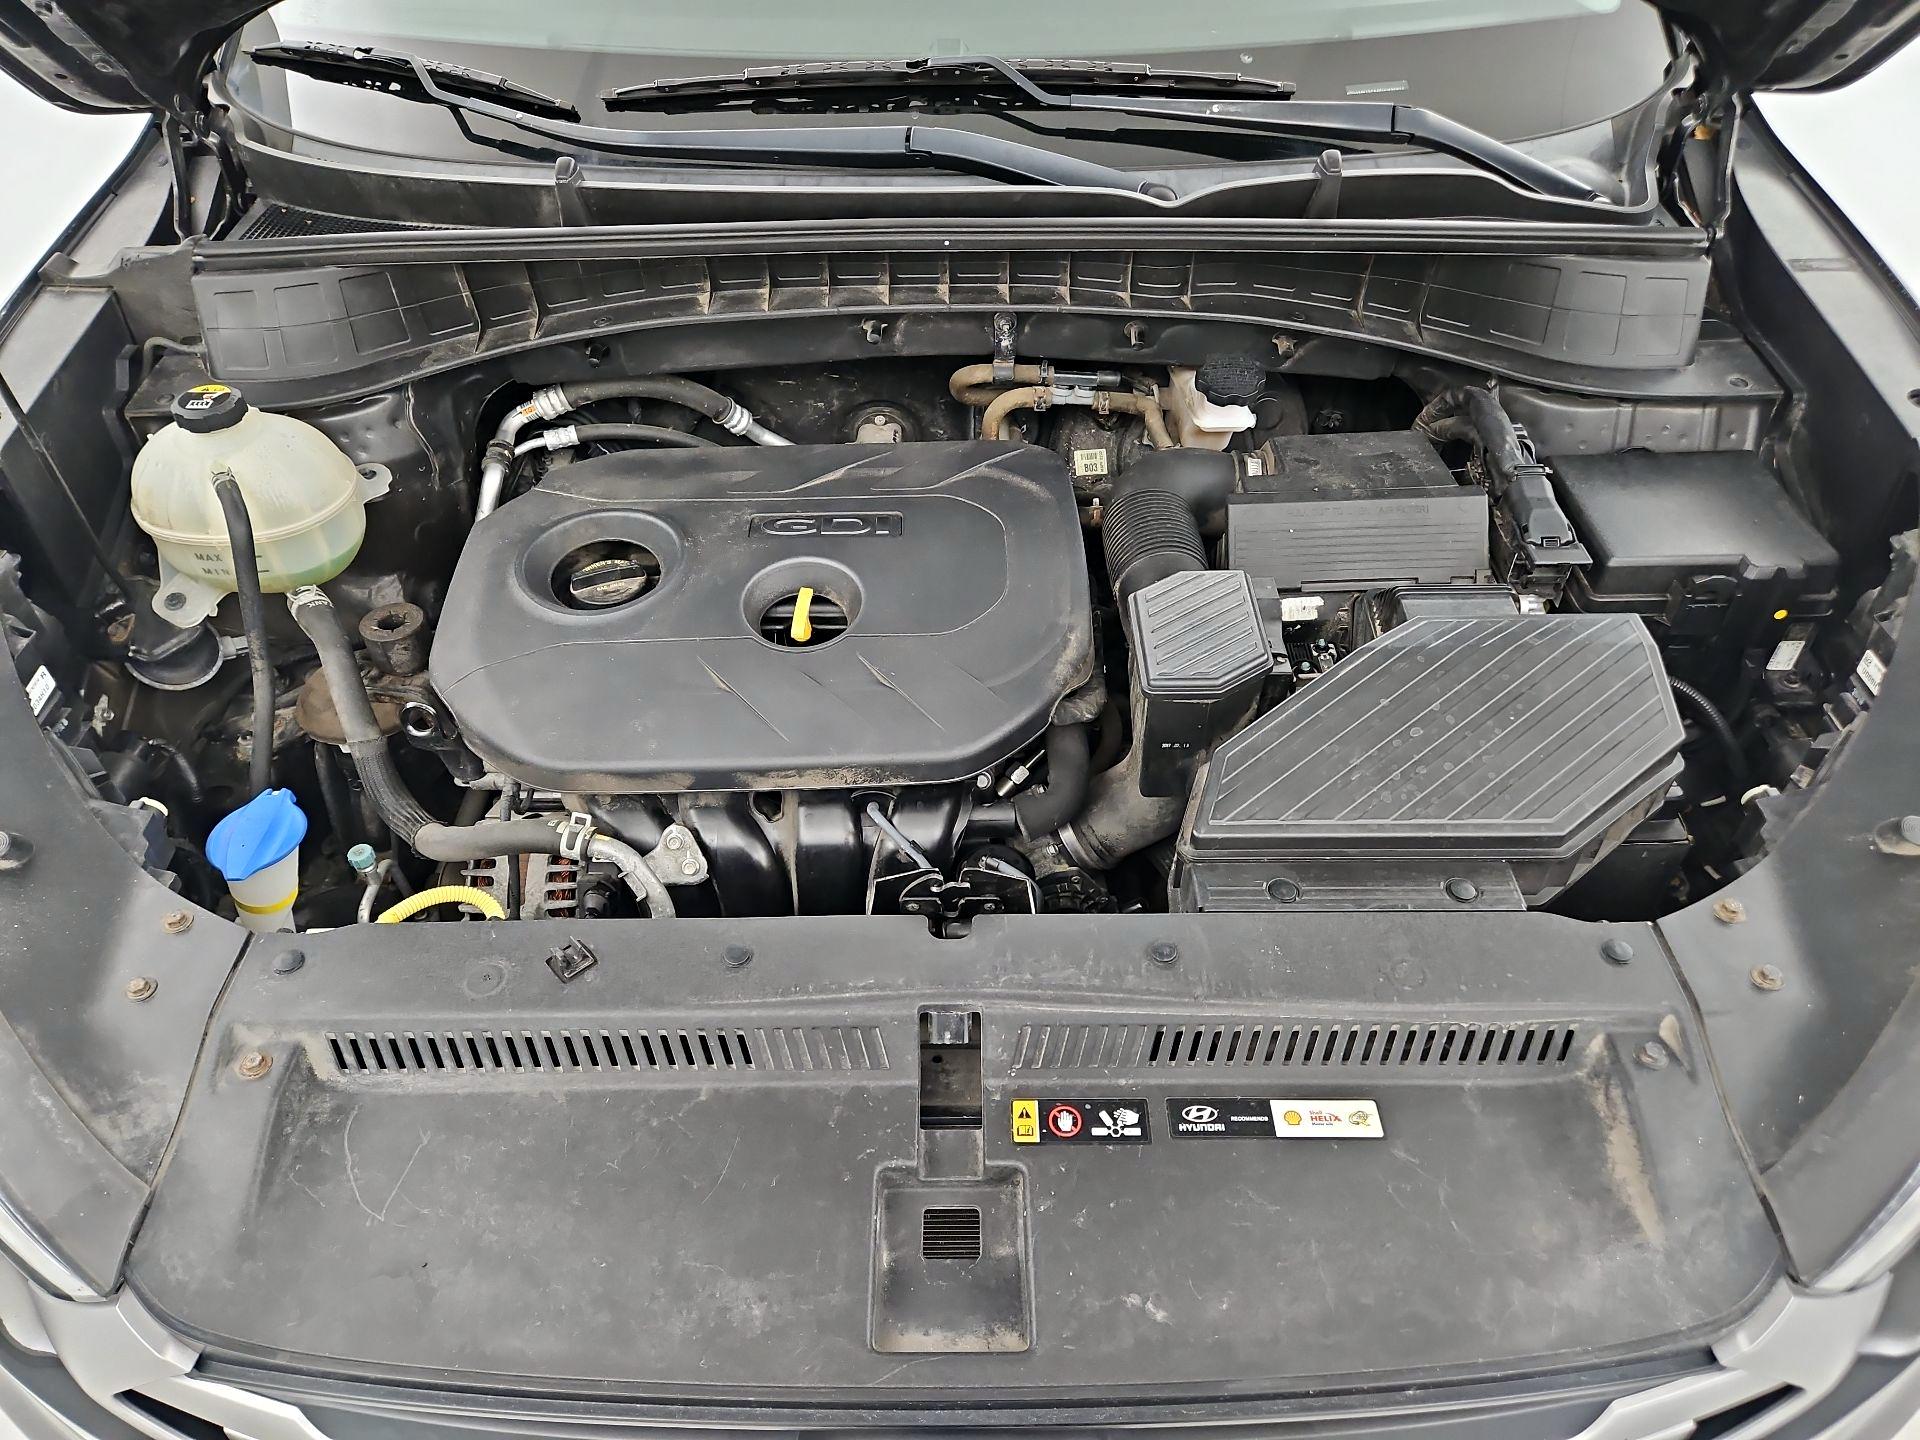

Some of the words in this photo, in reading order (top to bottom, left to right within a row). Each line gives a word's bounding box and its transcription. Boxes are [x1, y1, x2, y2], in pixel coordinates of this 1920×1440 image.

[761, 517, 893, 535] GDI
[194, 552, 224, 562] MAX
[201, 566, 232, 576] MIN
[1310, 1114, 1342, 1122] HELIX
[1178, 1122, 1226, 1132] HYUNDAI
